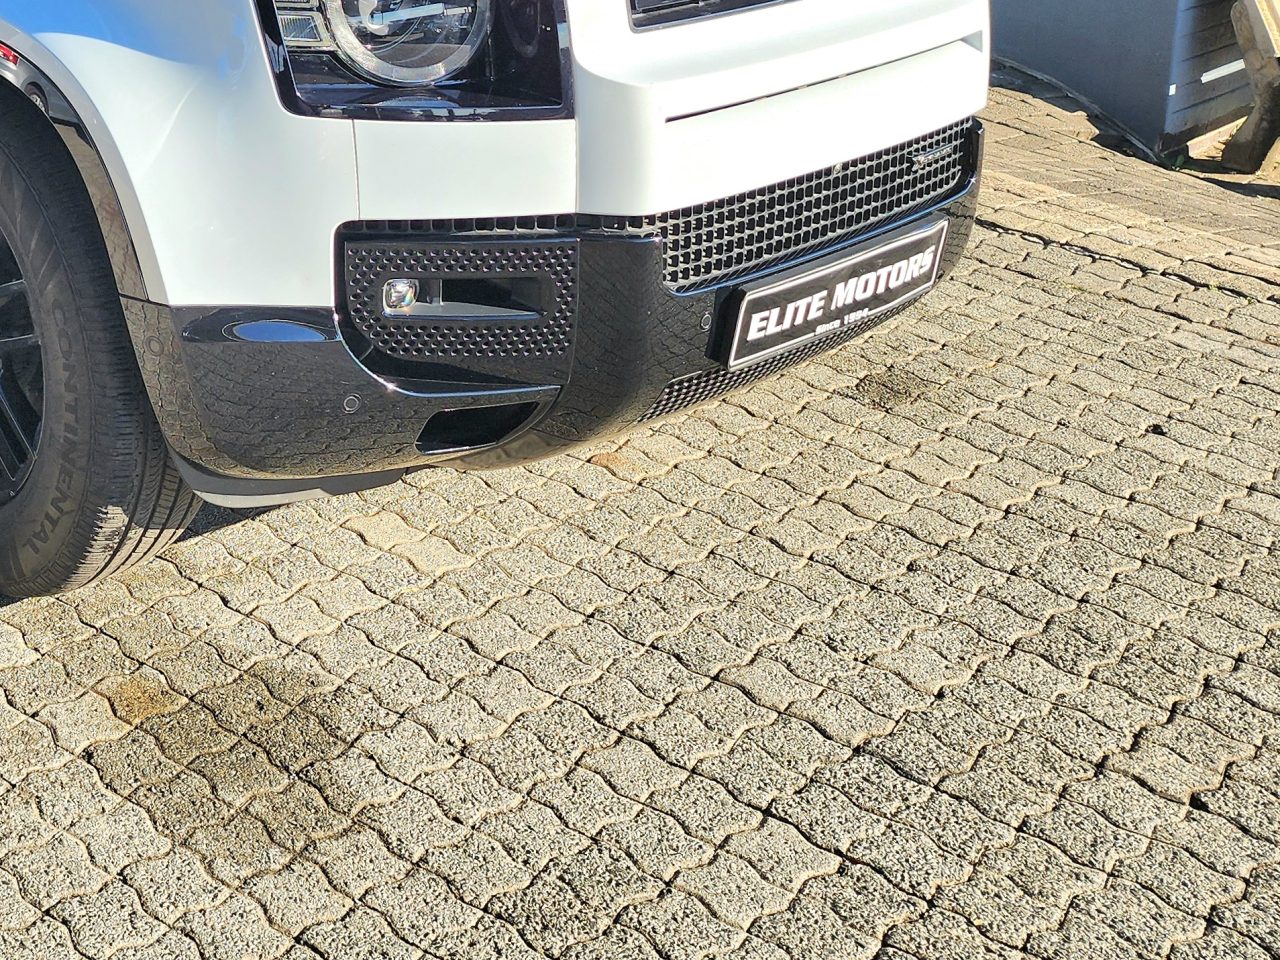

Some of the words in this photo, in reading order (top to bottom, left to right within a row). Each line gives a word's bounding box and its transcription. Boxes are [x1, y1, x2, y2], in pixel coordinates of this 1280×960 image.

[747, 290, 828, 341] ELITE
[830, 245, 936, 311] MOTORS
[843, 308, 869, 326] 1994
[24, 298, 78, 555] CONTINENTAL
